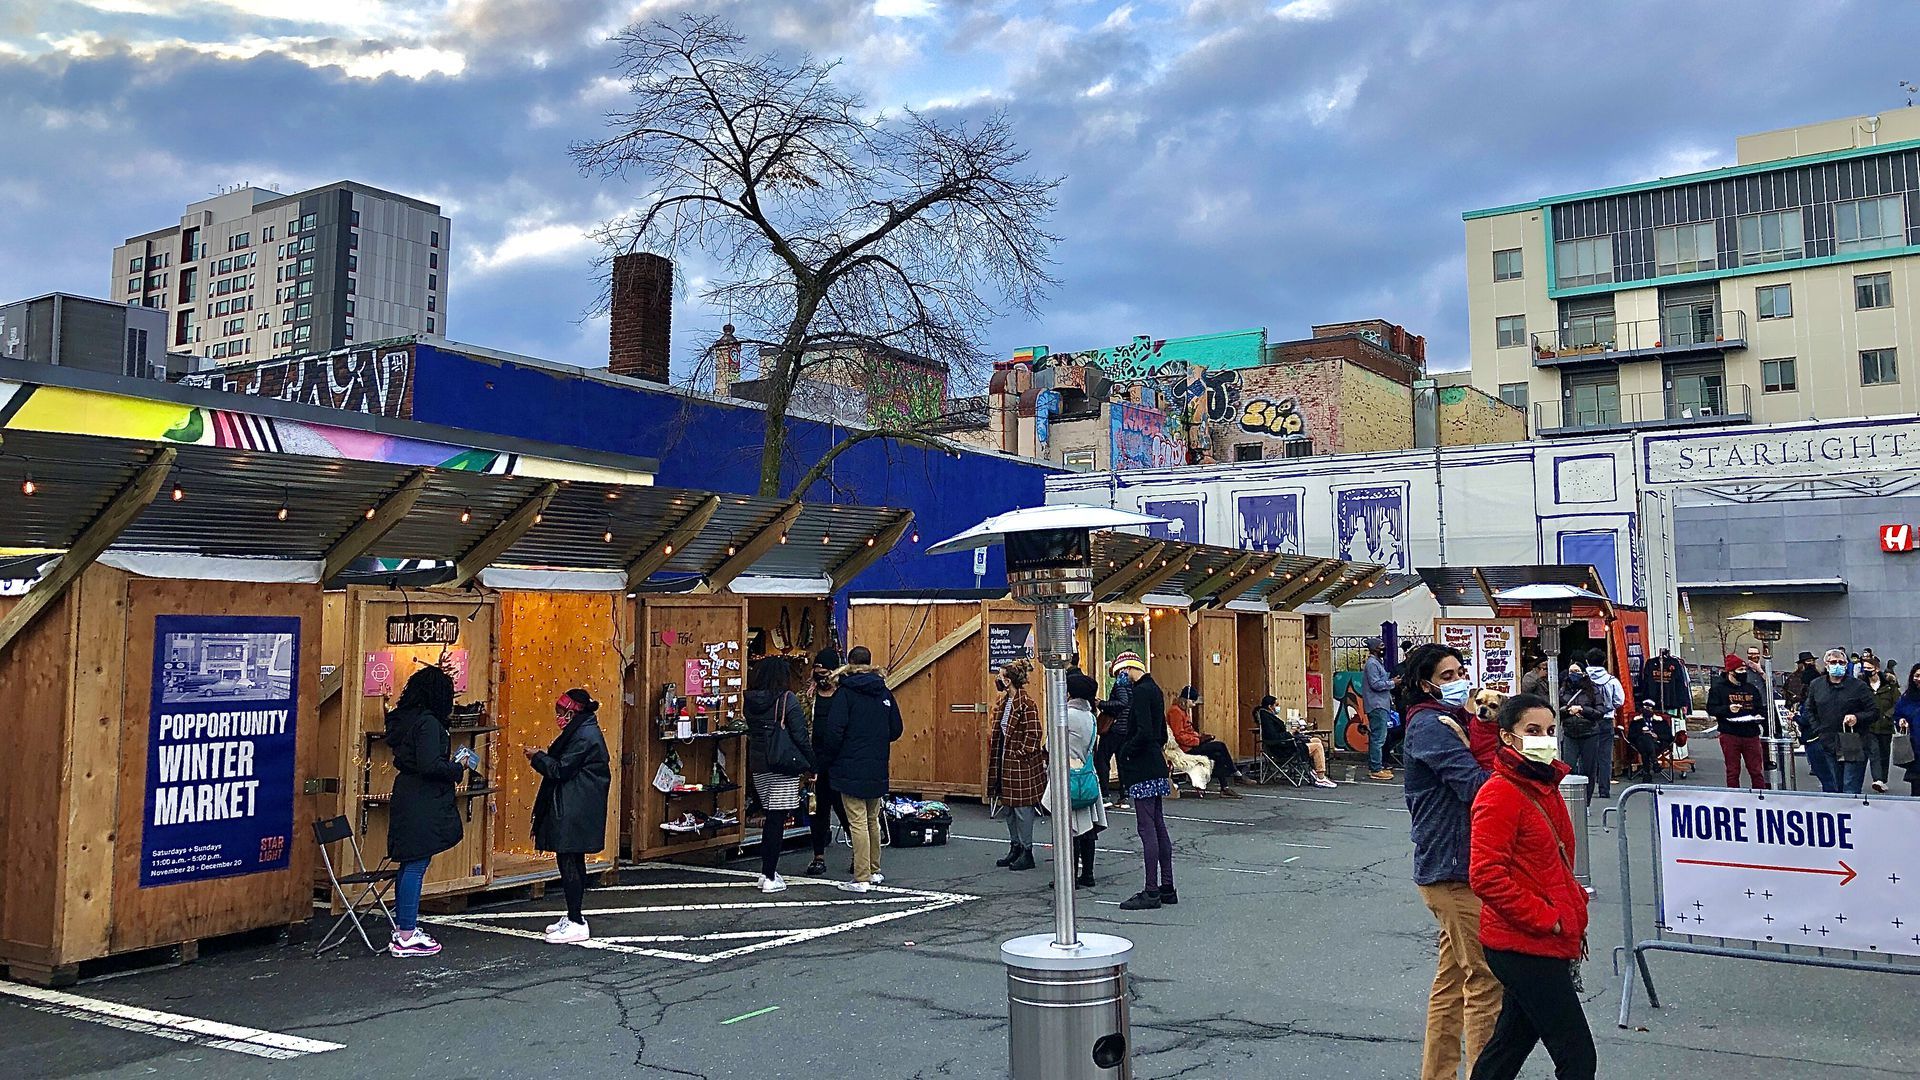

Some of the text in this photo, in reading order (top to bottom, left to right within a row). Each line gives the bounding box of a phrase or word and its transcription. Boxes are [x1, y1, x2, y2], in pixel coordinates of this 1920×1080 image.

[1679, 432, 1907, 470] STARLIGHT
[651, 631, 661, 647] I
[1484, 640, 1506, 649] SALE
[159, 709, 289, 740] POPPORTUNITY
[158, 740, 255, 783] WINTER
[153, 780, 260, 826] MARKET
[1671, 803, 1854, 850] MORE INSIDE
[152, 848, 187, 857] Saturdays
[193, 844, 222, 853] Sundays
[260, 836, 284, 851] STAR
[152, 859, 171, 867] 11:00
[191, 854, 207, 862] 5:00
[207, 853, 222, 861] p.m.
[258, 849, 283, 863] LIGHT
[150, 868, 186, 877] November
[186, 865, 196, 873] 28
[200, 861, 233, 871] December
